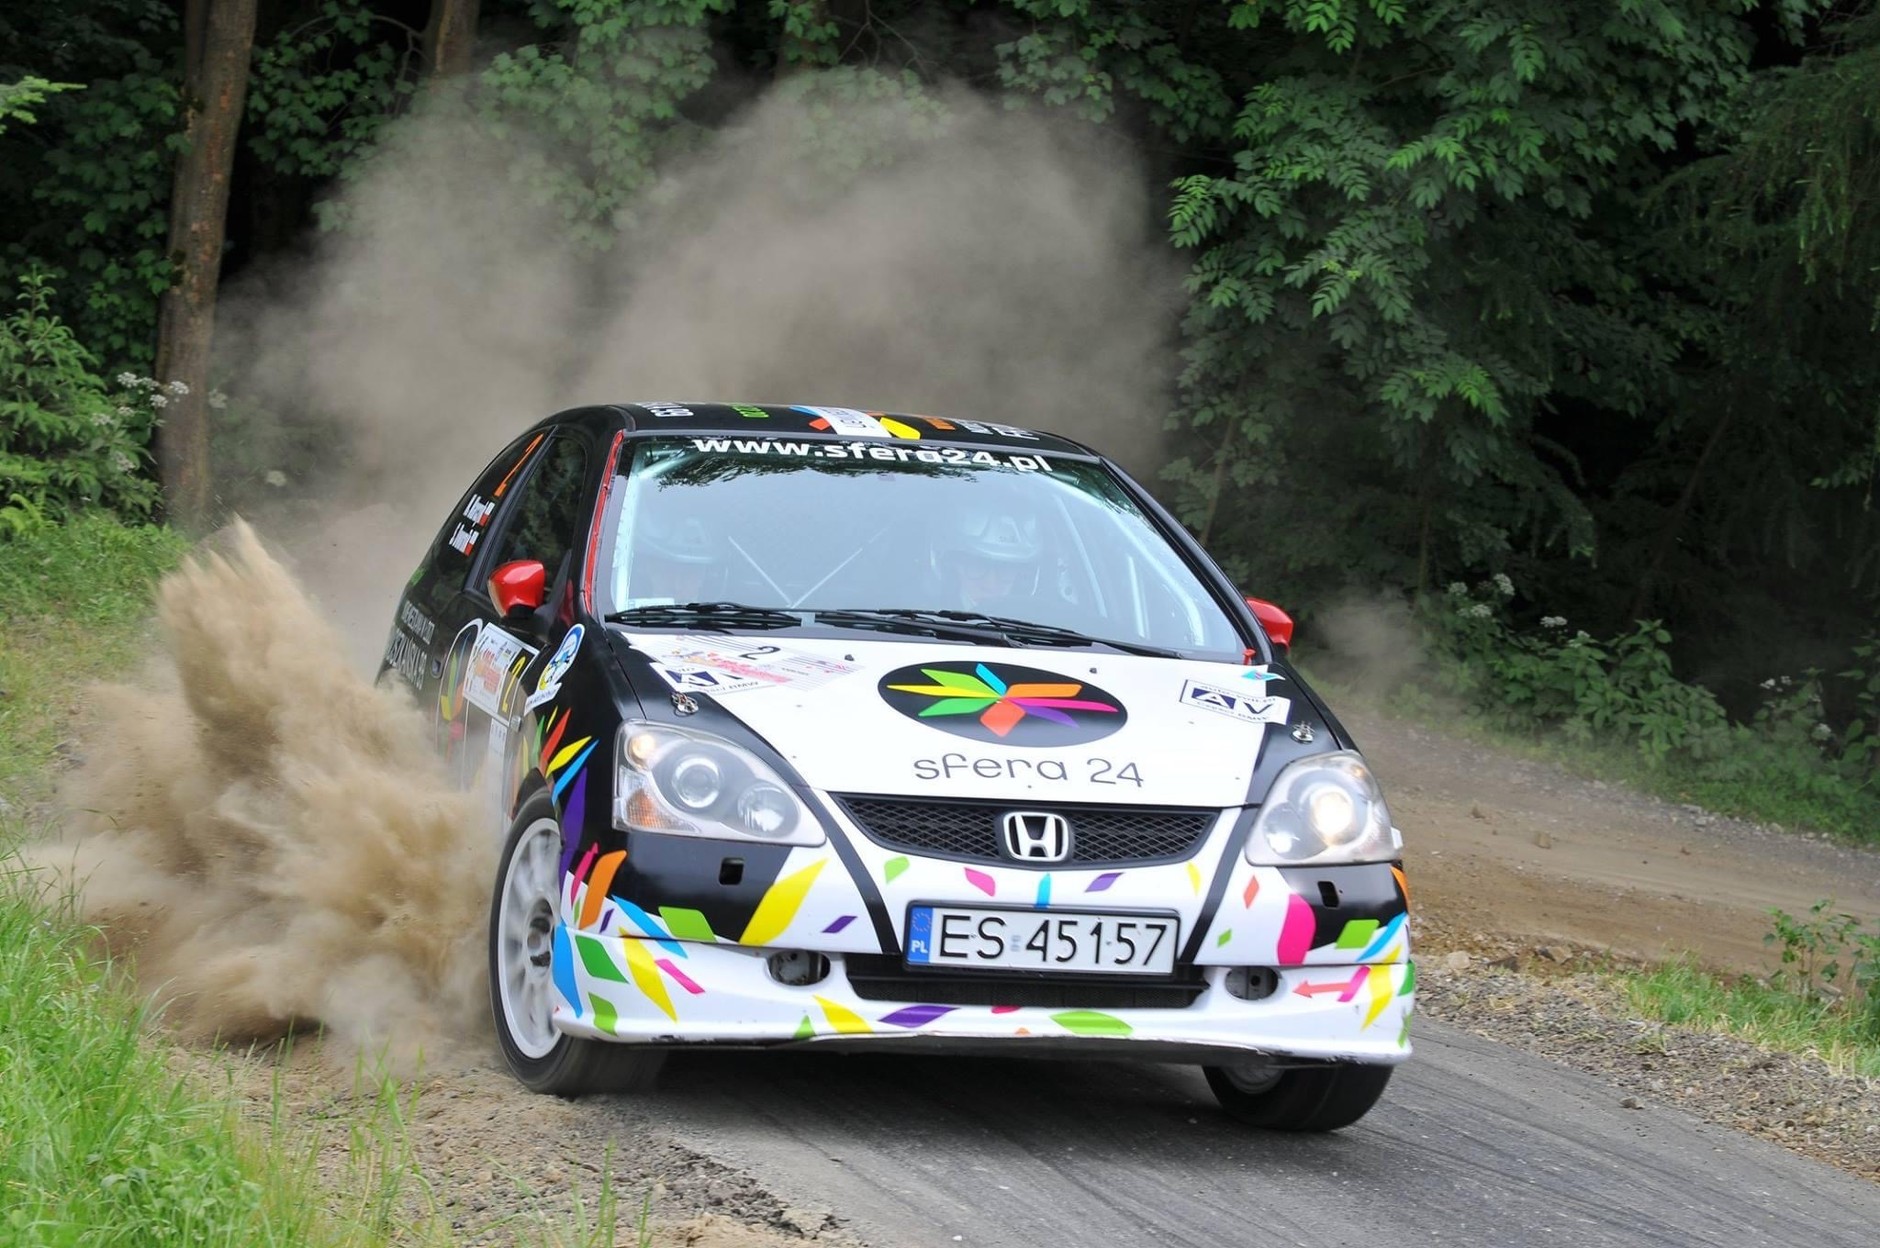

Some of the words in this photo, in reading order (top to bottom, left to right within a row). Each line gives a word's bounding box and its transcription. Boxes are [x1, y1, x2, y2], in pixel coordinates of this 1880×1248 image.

[692, 438, 1054, 472] www.sfera24.pl
[738, 646, 782, 661] 2
[912, 752, 1069, 781] sfera
[1086, 757, 1145, 788] 24
[911, 940, 929, 954] PL
[939, 914, 1008, 960] ES
[1025, 918, 1168, 967] 45157
